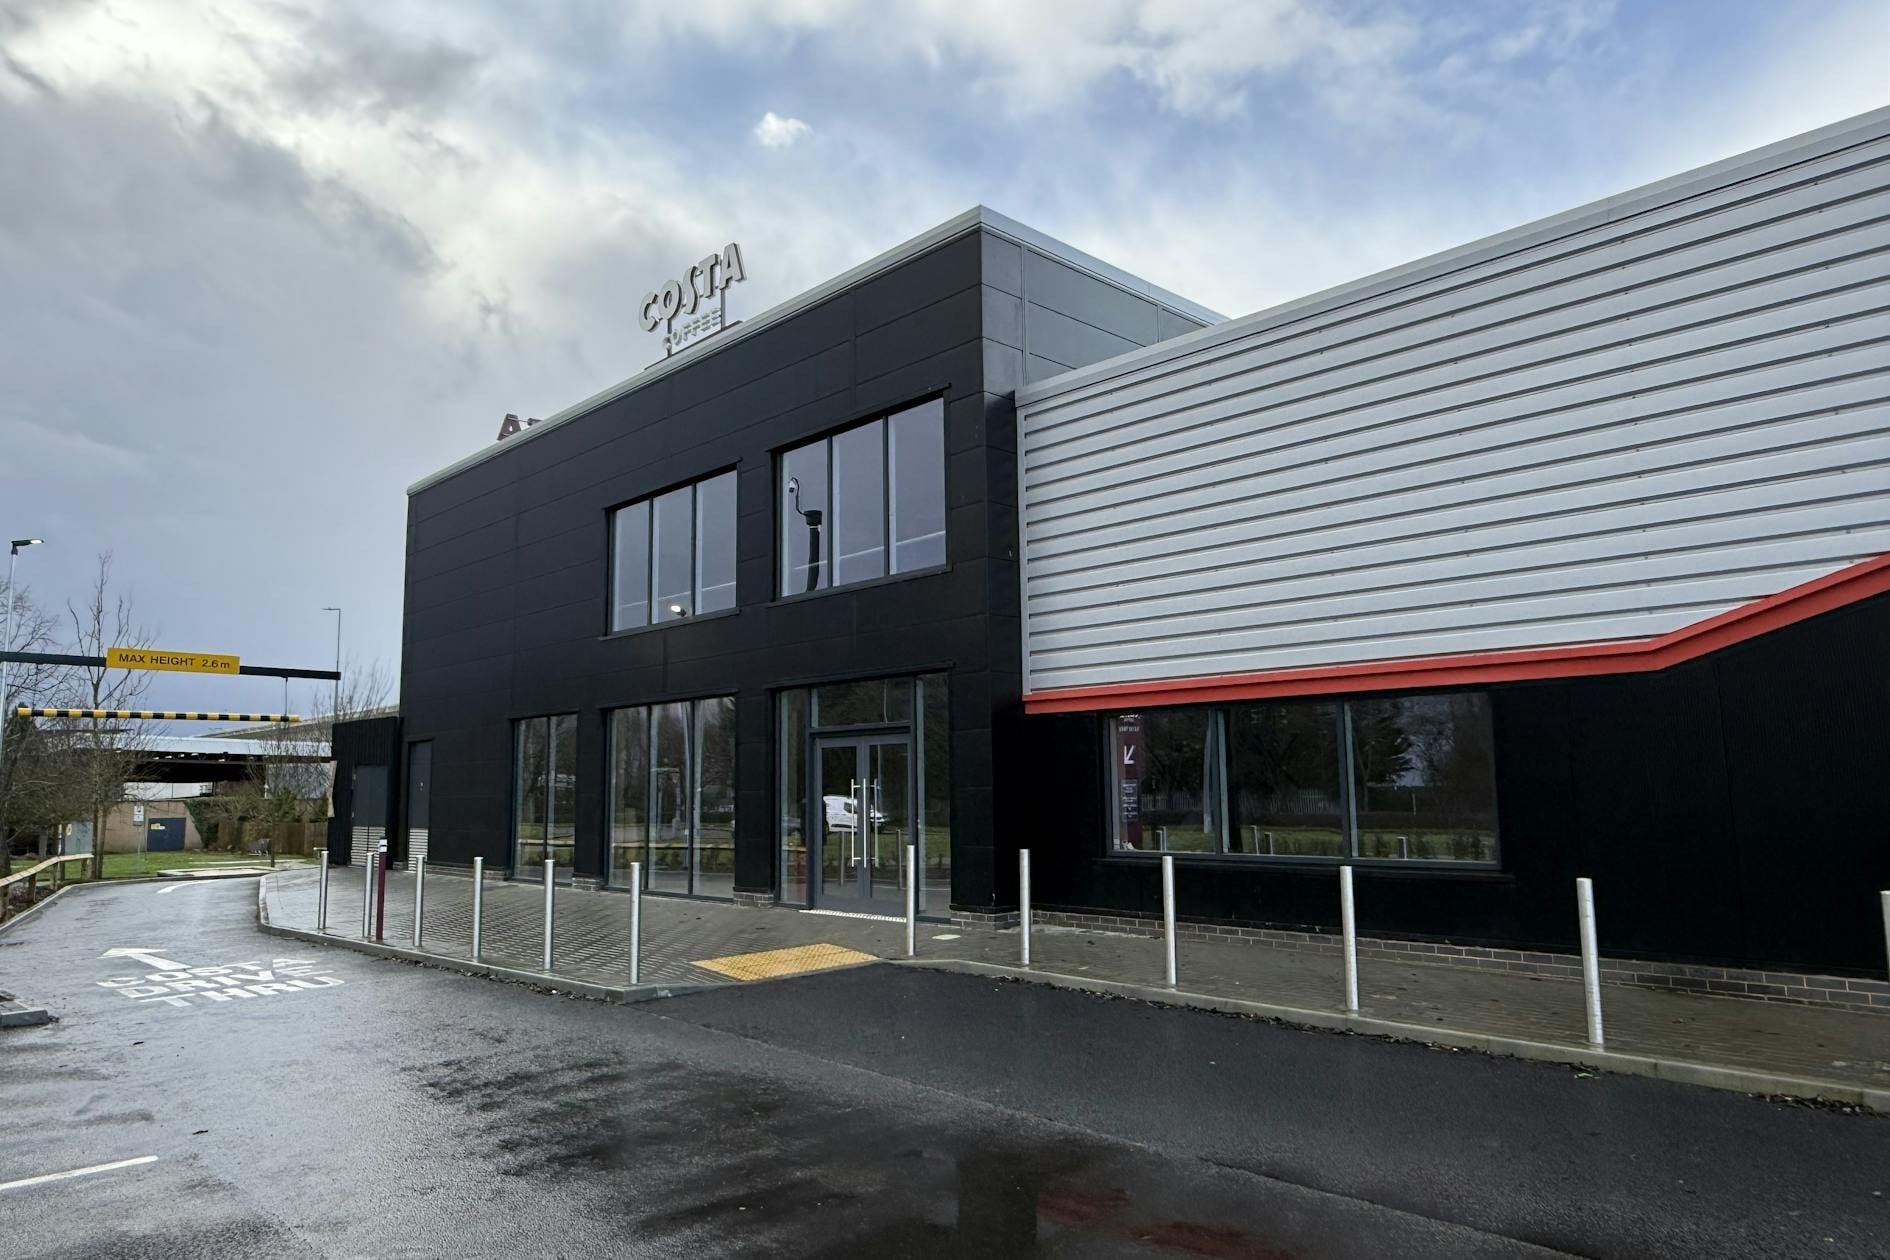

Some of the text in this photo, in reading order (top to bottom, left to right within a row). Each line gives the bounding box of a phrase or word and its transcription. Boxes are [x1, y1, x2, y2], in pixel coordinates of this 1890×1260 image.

[639, 242, 746, 333] COSTA
[118, 653, 146, 664] MAX
[150, 655, 196, 667] HEIGHT
[96, 958, 317, 988] COSTA
[115, 965, 334, 999] DRIVE
[140, 976, 345, 1008] THRU
